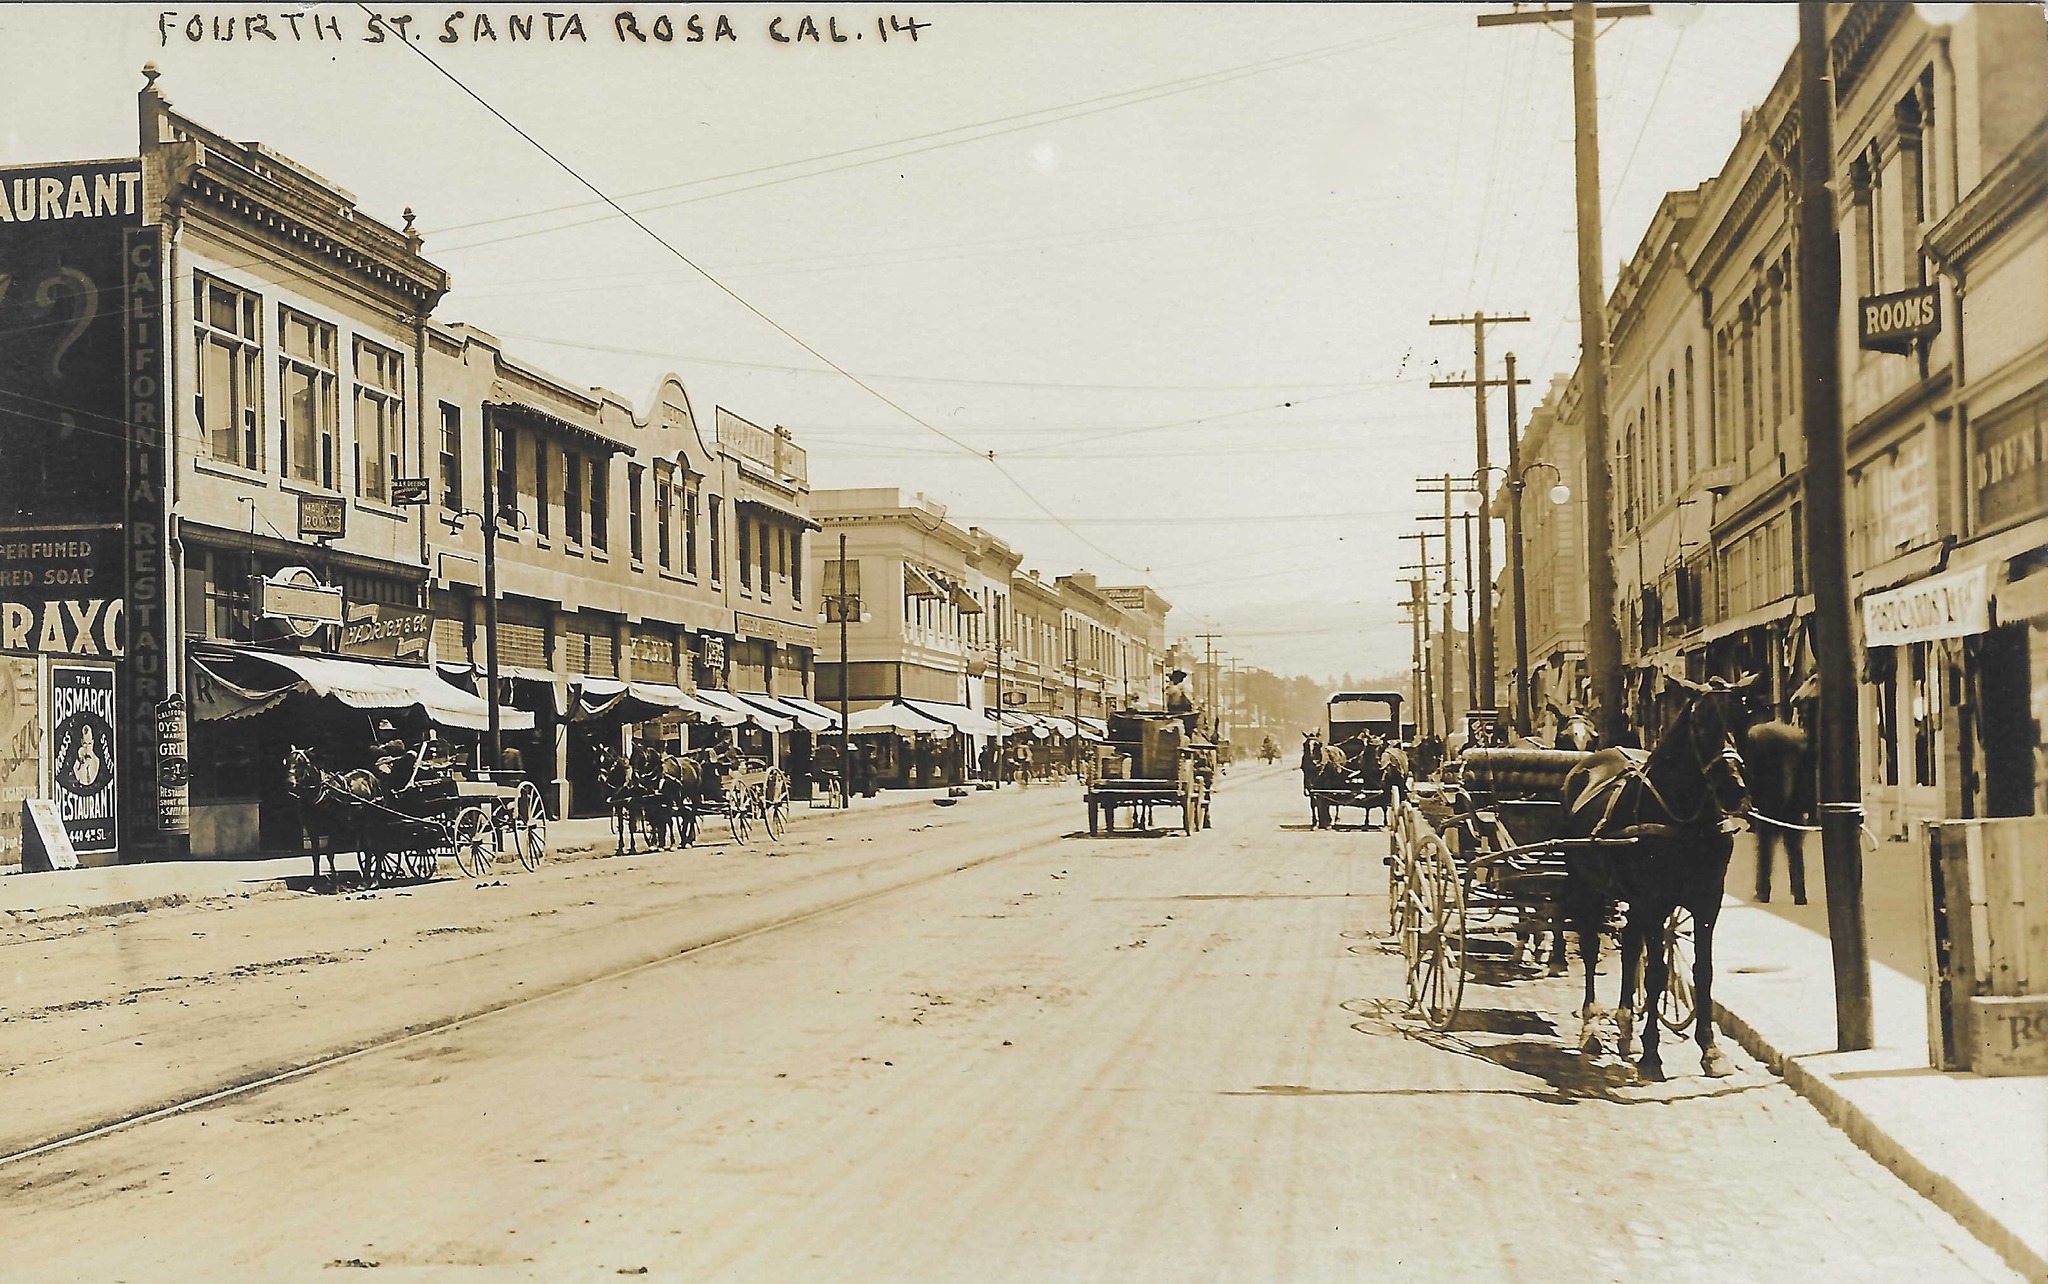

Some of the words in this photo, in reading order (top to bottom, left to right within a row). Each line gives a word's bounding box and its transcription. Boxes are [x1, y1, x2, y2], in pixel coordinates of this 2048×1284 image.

[1866, 295, 1934, 335] ROOMS
[131, 243, 157, 503] CALIFORNIA
[43, 569, 95, 585] SOAP
[132, 521, 158, 768] RESTAURANT
[75, 675, 92, 686] THE
[54, 687, 113, 730] BISMARCK
